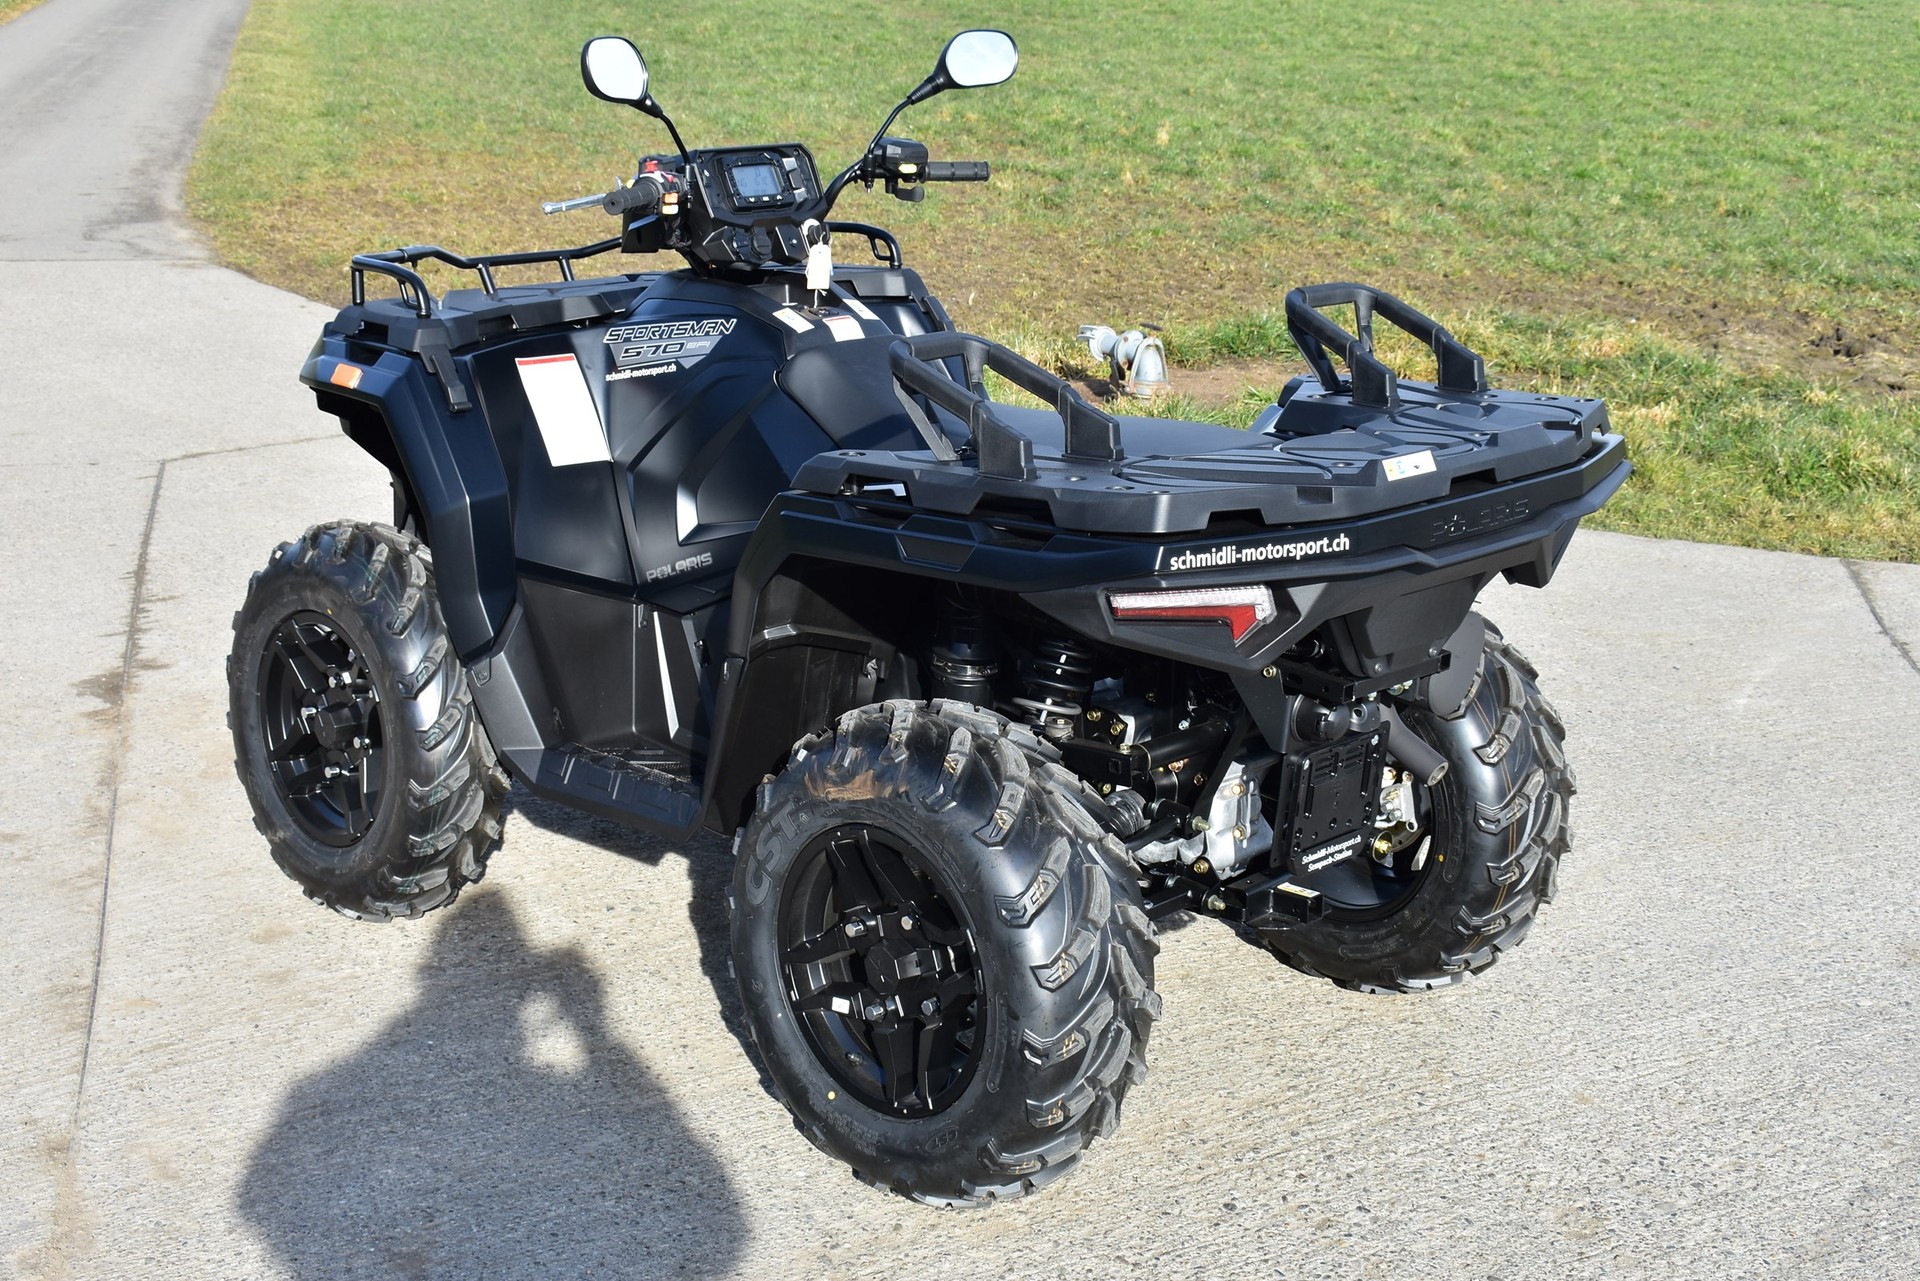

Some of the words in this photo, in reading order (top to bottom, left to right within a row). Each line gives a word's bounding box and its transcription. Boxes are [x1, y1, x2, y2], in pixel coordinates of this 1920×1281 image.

[603, 318, 737, 344] SPORTSMAN
[619, 341, 687, 361] 570
[605, 362, 677, 382] schmidli-motorsport.ch
[1169, 532, 1350, 571] schmidli-motorsport.ch
[645, 551, 714, 583] POLARIS
